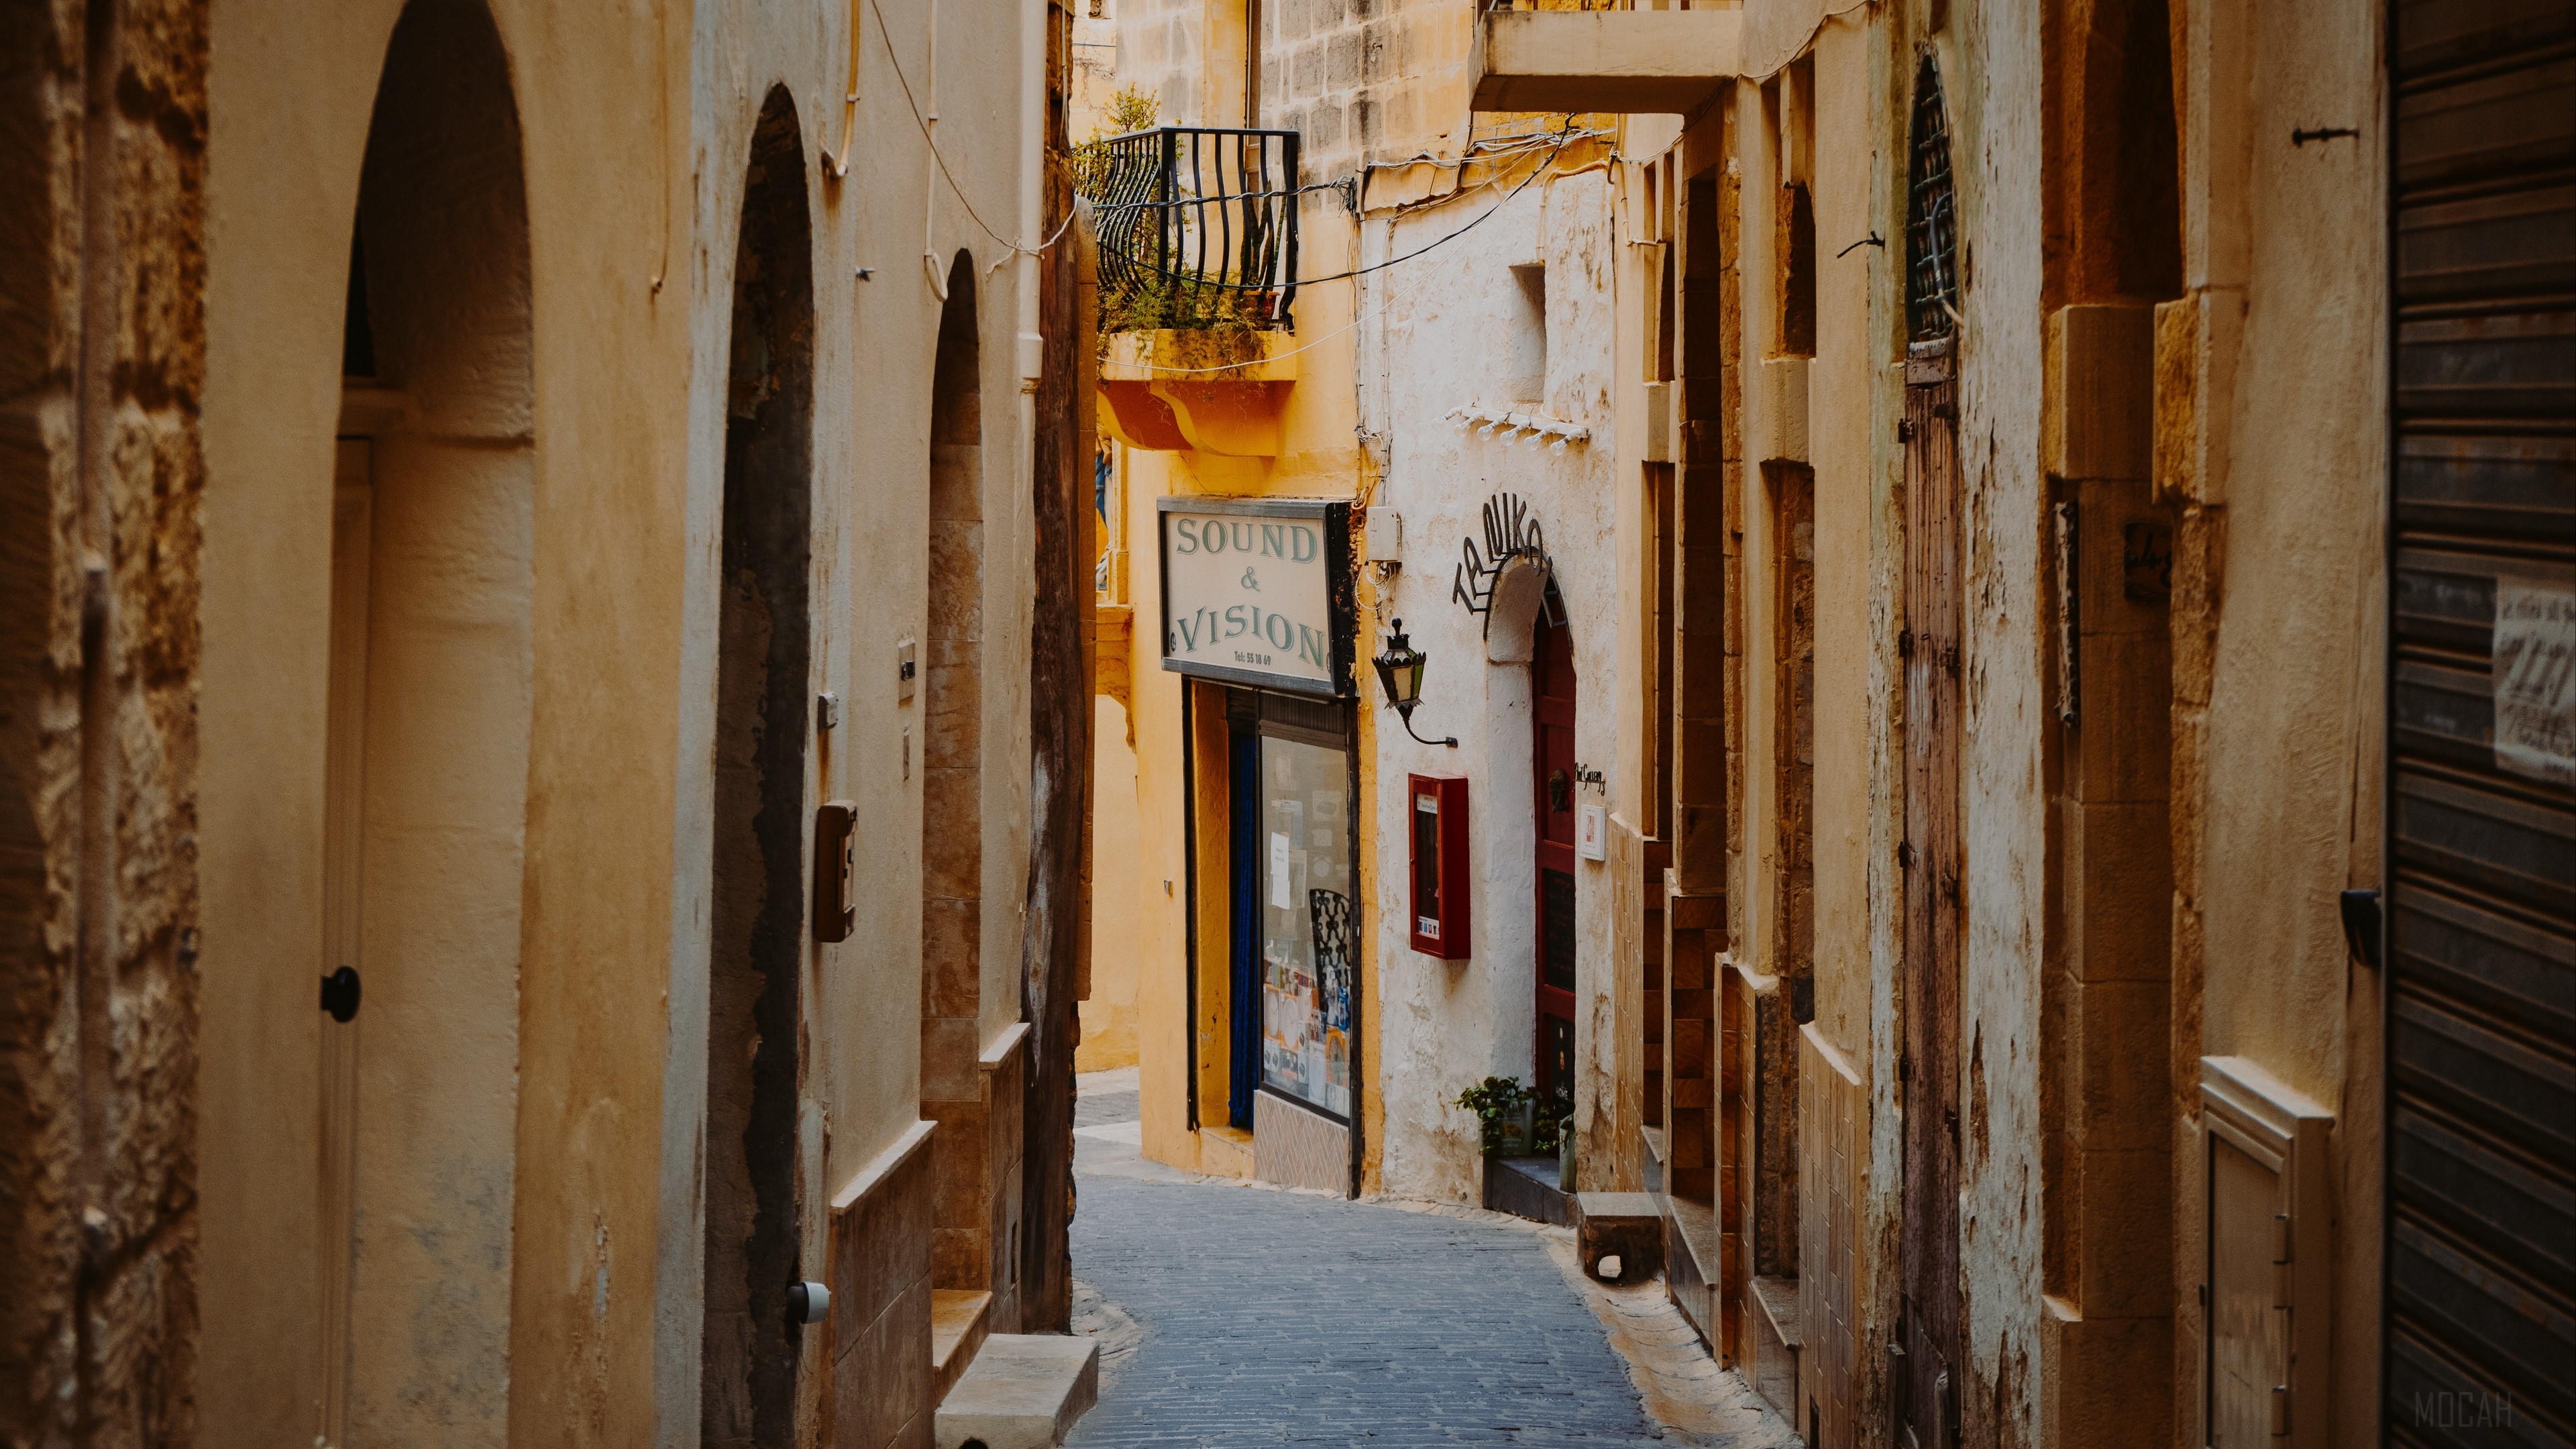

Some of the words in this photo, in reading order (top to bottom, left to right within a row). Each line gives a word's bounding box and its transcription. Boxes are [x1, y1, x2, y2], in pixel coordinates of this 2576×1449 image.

[1176, 518, 1318, 564] SOUND
[1240, 566, 1261, 592] &
[1177, 604, 1325, 671] VISION
[1234, 651, 1245, 662] Tel:
[1247, 652, 1254, 663] 55
[1255, 653, 1262, 665] 18
[1263, 654, 1271, 665] 69
